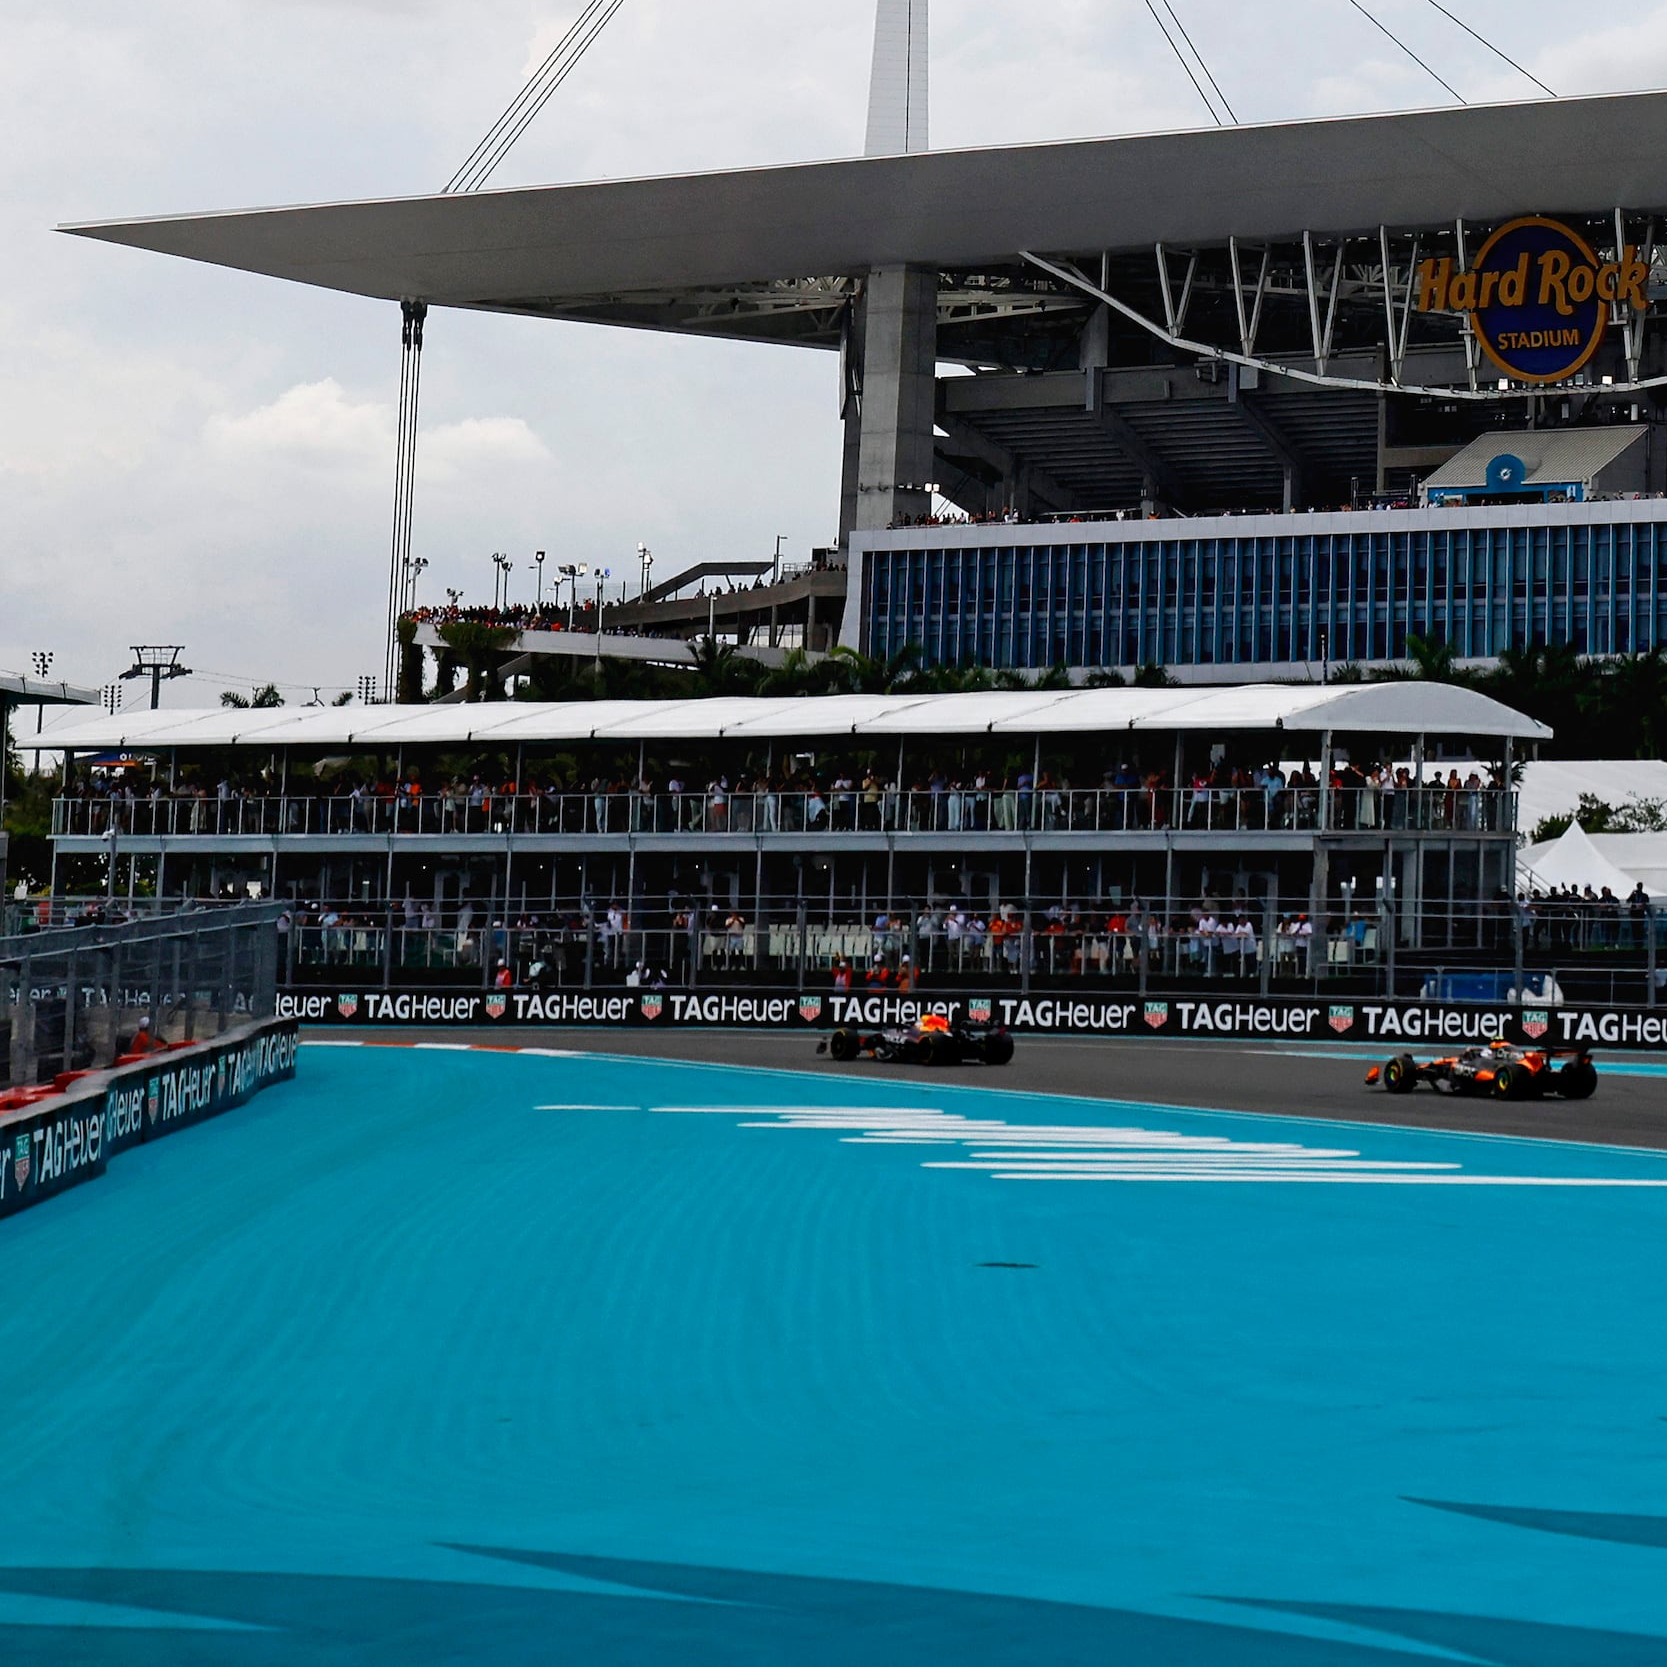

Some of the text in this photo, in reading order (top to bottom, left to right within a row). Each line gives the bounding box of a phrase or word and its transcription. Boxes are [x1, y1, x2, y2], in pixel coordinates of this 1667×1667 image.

[1417, 244, 1649, 316] Hard Rock
[1498, 328, 1580, 350] STADIUM
[364, 994, 480, 1019] TAGHeuer
[513, 994, 634, 1020] TAGHeuer
[670, 995, 795, 1022] TAGHeuer
[999, 999, 1136, 1029] TAGHeuer
[1176, 1002, 1320, 1032] TAGHeuer
[1523, 1011, 1548, 1021] TAG
[1362, 1006, 1513, 1038] TAGHeuer
